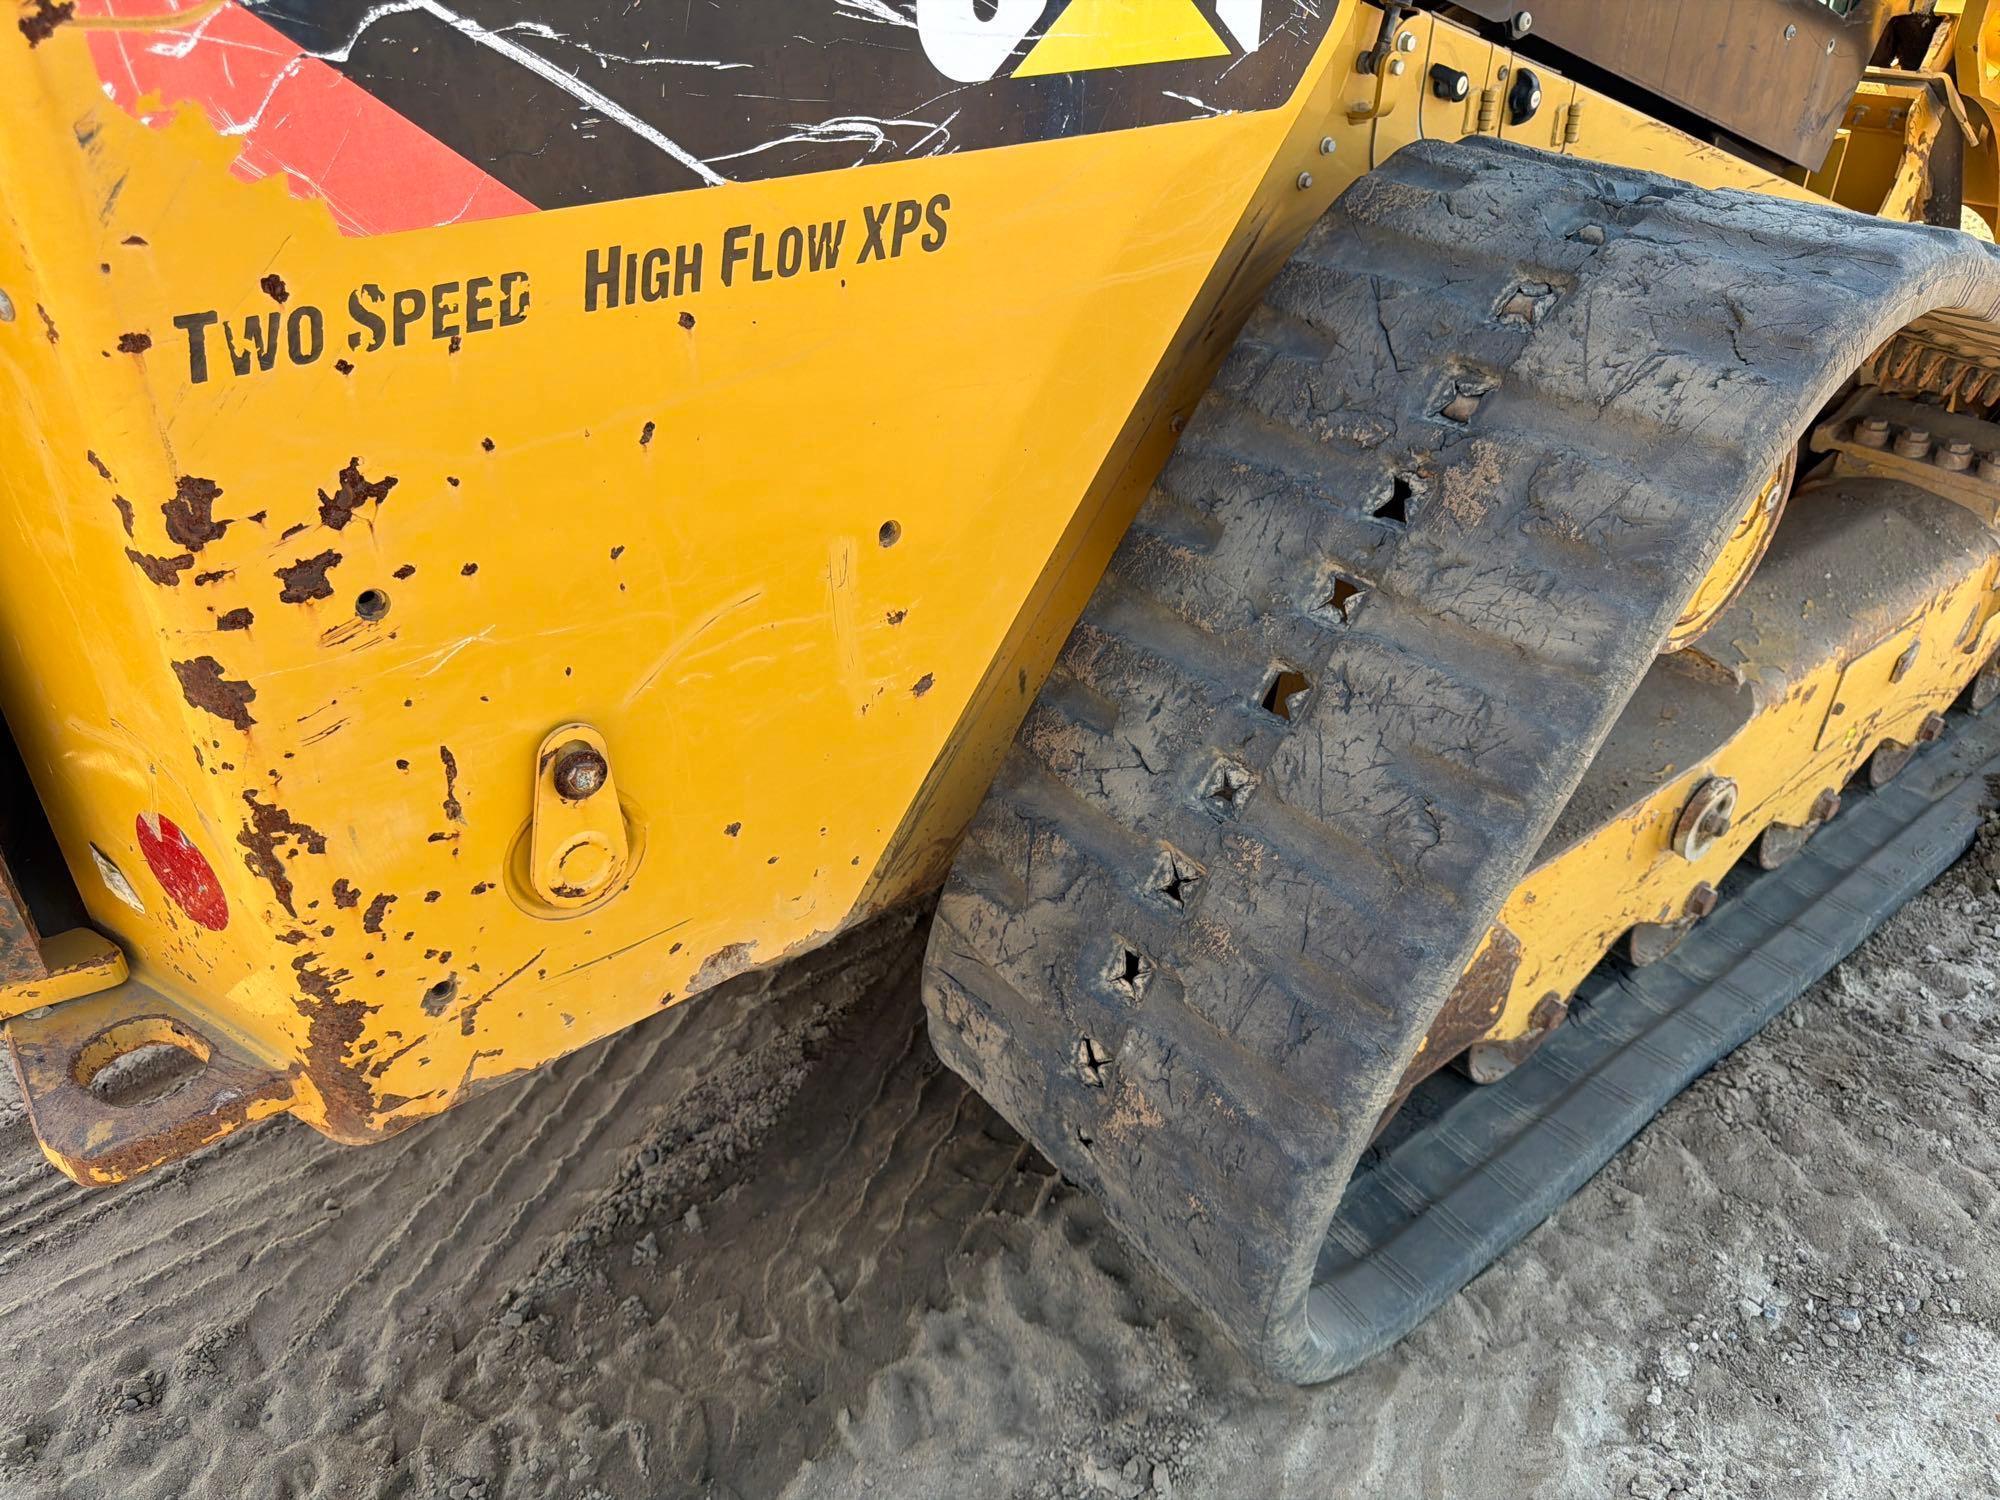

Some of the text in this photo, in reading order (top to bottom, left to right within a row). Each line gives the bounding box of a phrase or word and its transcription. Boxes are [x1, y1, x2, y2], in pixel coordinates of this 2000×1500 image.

[584, 193, 951, 312] HIGH FLOW XPS
[173, 271, 531, 384] TWO SPEED
